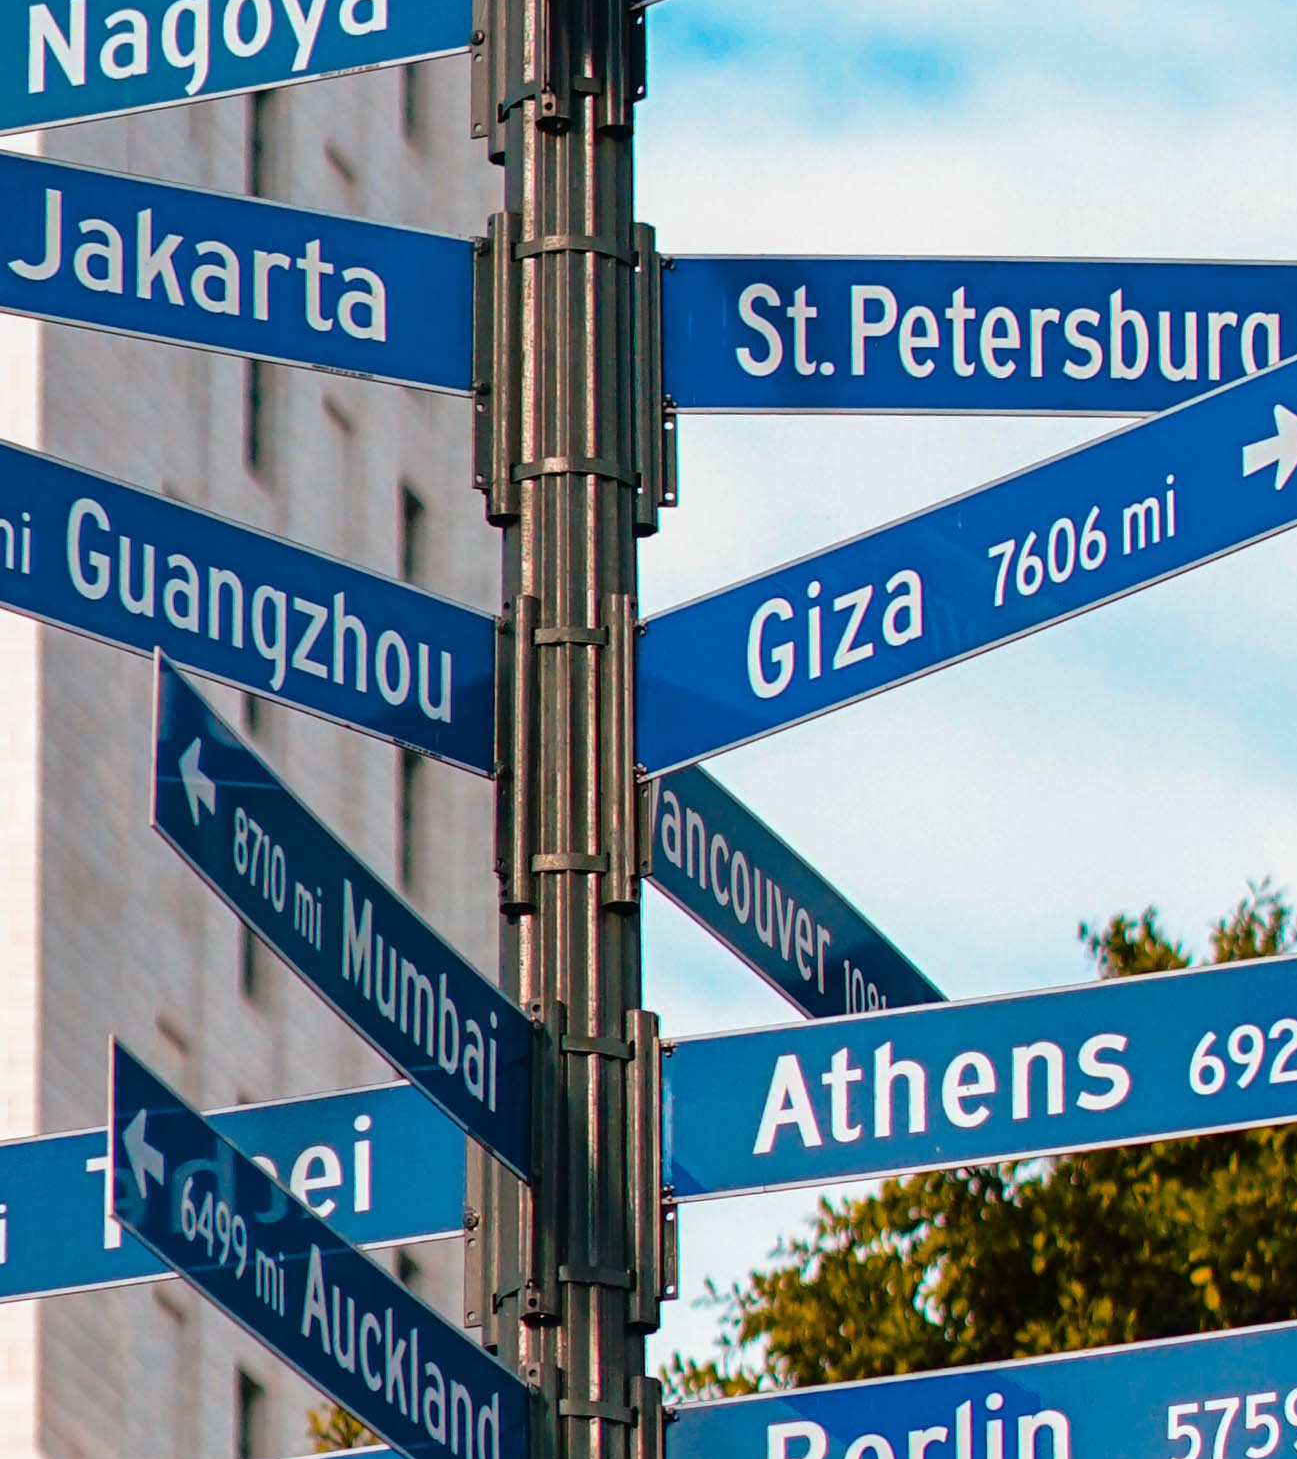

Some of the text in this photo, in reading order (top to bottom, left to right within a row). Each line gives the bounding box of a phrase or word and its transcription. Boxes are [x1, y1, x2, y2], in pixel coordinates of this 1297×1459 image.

[8, 188, 387, 343] Jakarta
[67, 498, 452, 724] Guangzhou
[747, 475, 1176, 699] Giza 7606 mi
[234, 807, 497, 1112] 8710 mi Mumbai
[653, 778, 830, 994] ancouver
[753, 1033, 1132, 1155] Athens
[180, 1176, 248, 1279] 6499
[256, 1250, 285, 1317] mi
